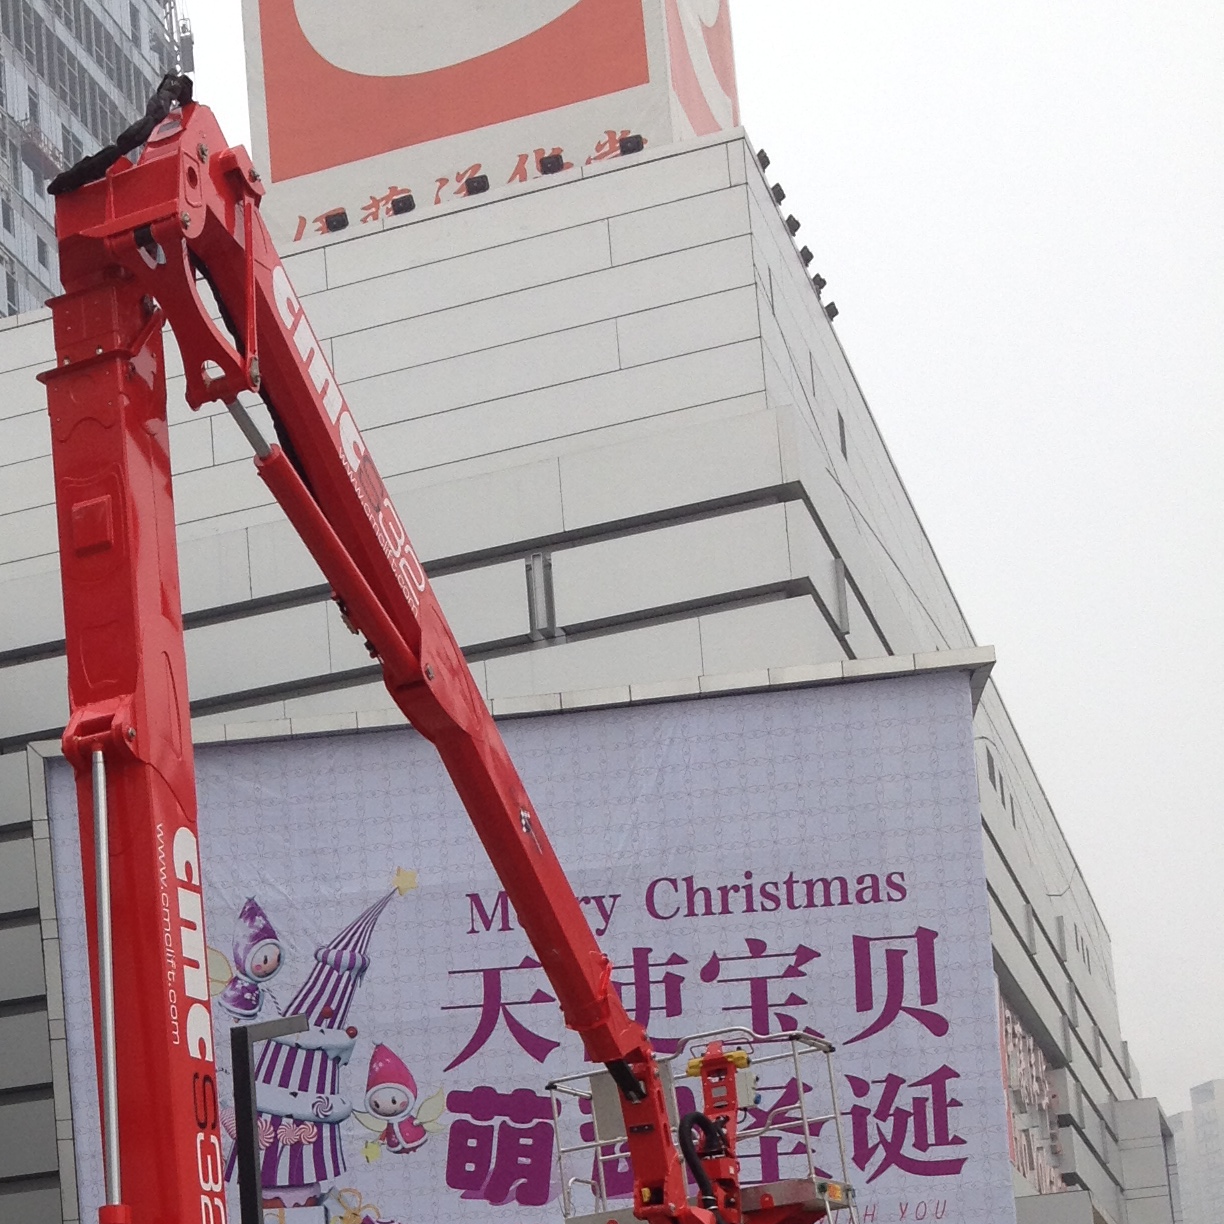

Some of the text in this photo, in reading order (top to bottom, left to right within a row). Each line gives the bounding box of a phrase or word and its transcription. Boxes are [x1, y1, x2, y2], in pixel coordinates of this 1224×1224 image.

[645, 869, 908, 922] Christmas
[156, 822, 180, 1046] www.cmclift.com
[899, 1199, 947, 1222] YOU
